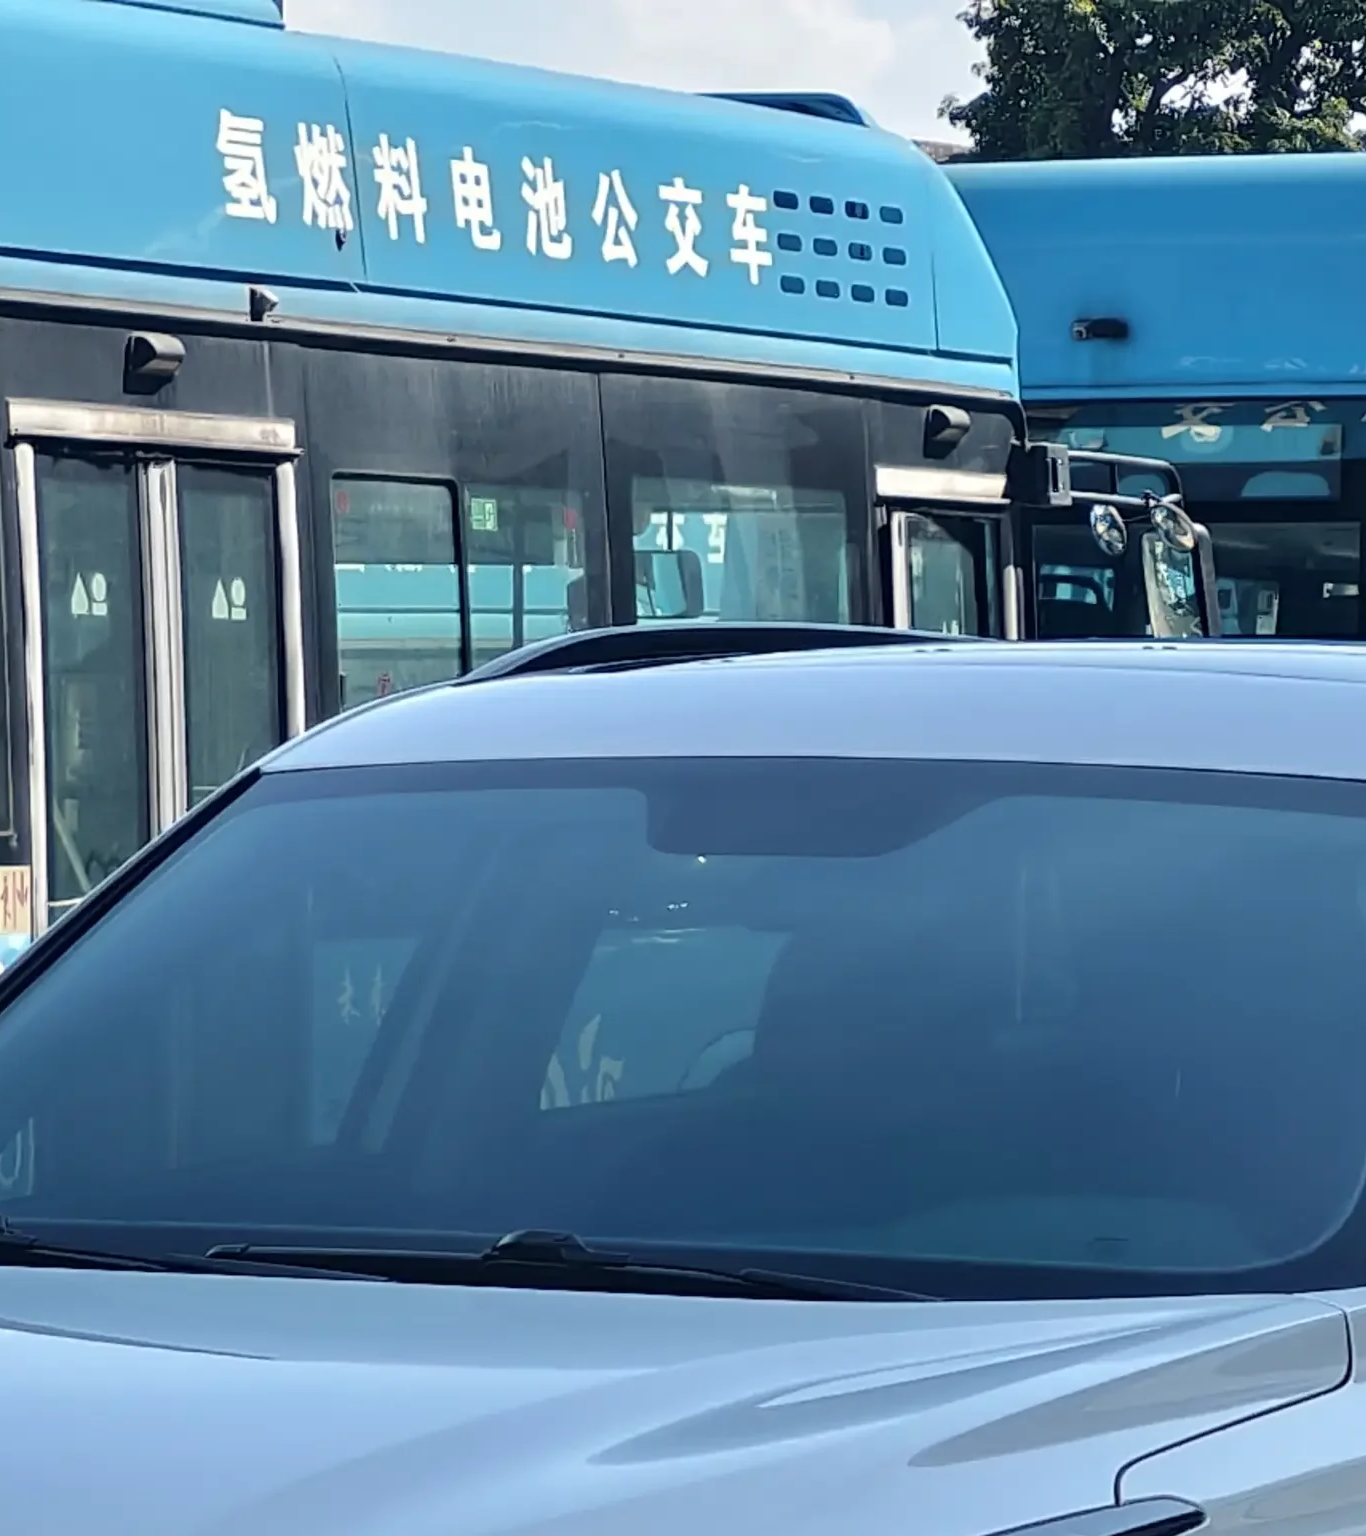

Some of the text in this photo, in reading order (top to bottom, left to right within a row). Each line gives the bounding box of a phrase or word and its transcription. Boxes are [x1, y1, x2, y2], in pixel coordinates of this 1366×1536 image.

[216, 108, 773, 286] 氢燃料电池公交车
